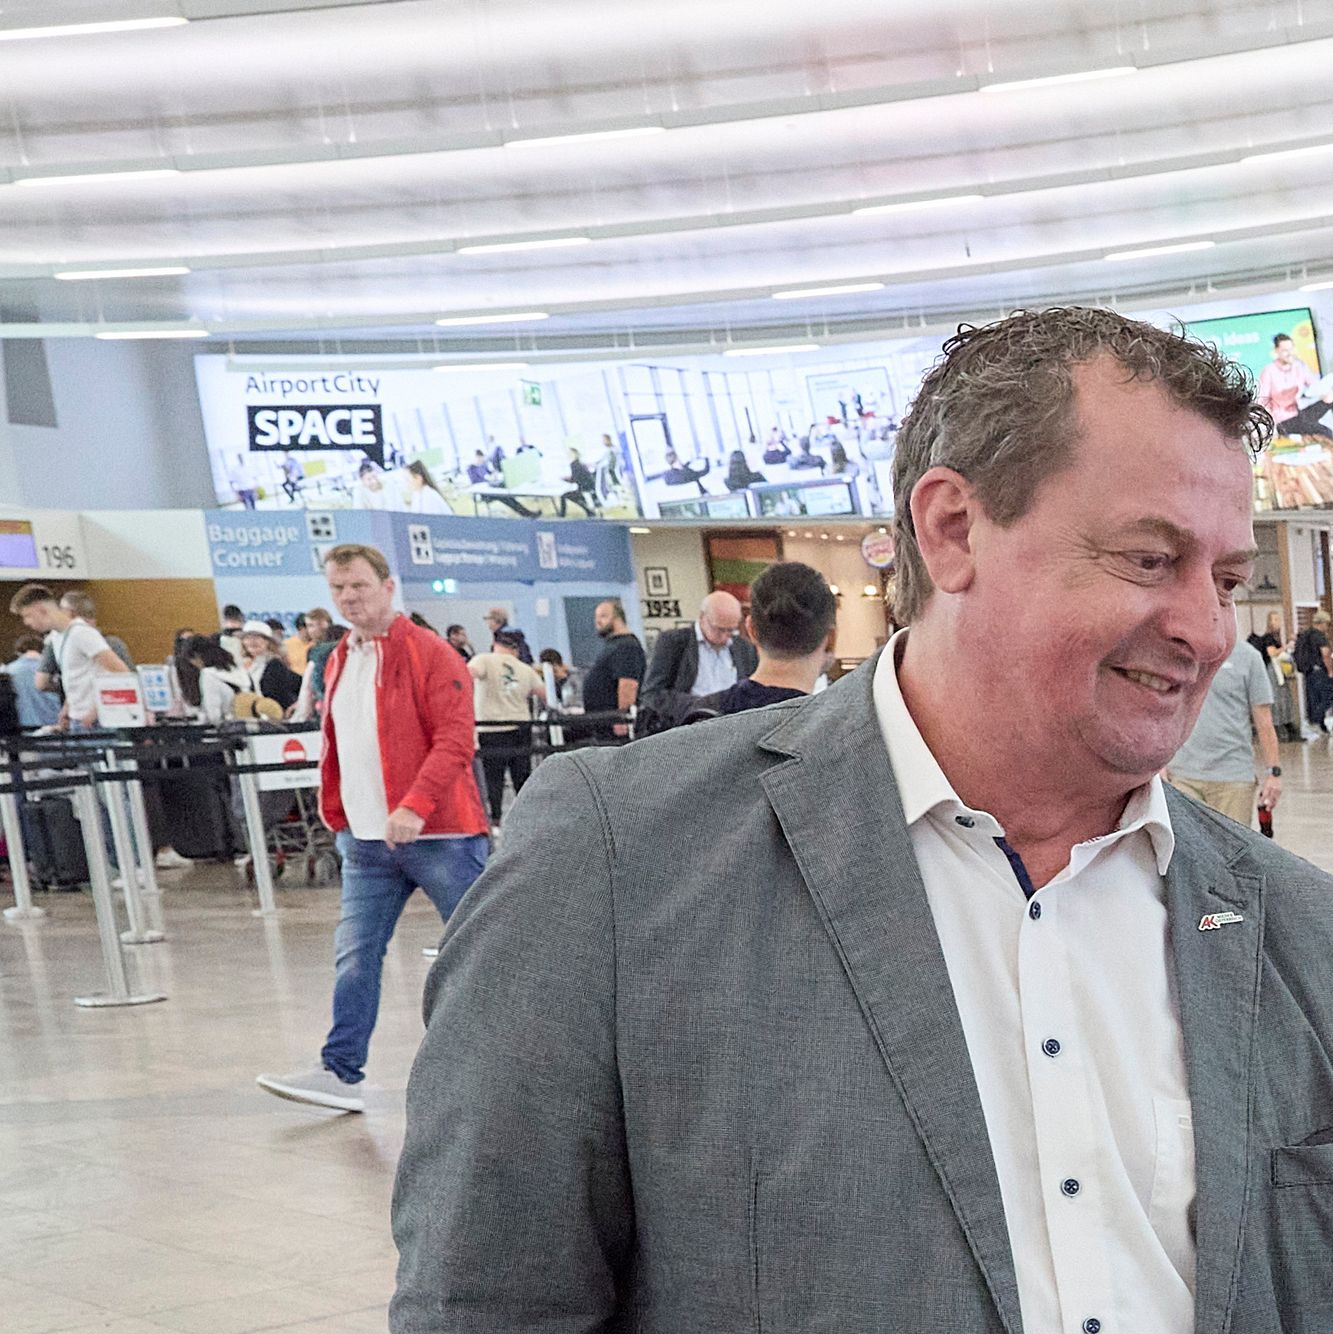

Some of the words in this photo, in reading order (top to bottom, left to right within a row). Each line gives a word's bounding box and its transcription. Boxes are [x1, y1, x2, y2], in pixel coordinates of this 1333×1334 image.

[254, 409, 377, 446] SPACE
[208, 524, 299, 546] Baggage
[42, 545, 77, 569] 196
[214, 549, 284, 568] Corner
[645, 600, 682, 618] 1954
